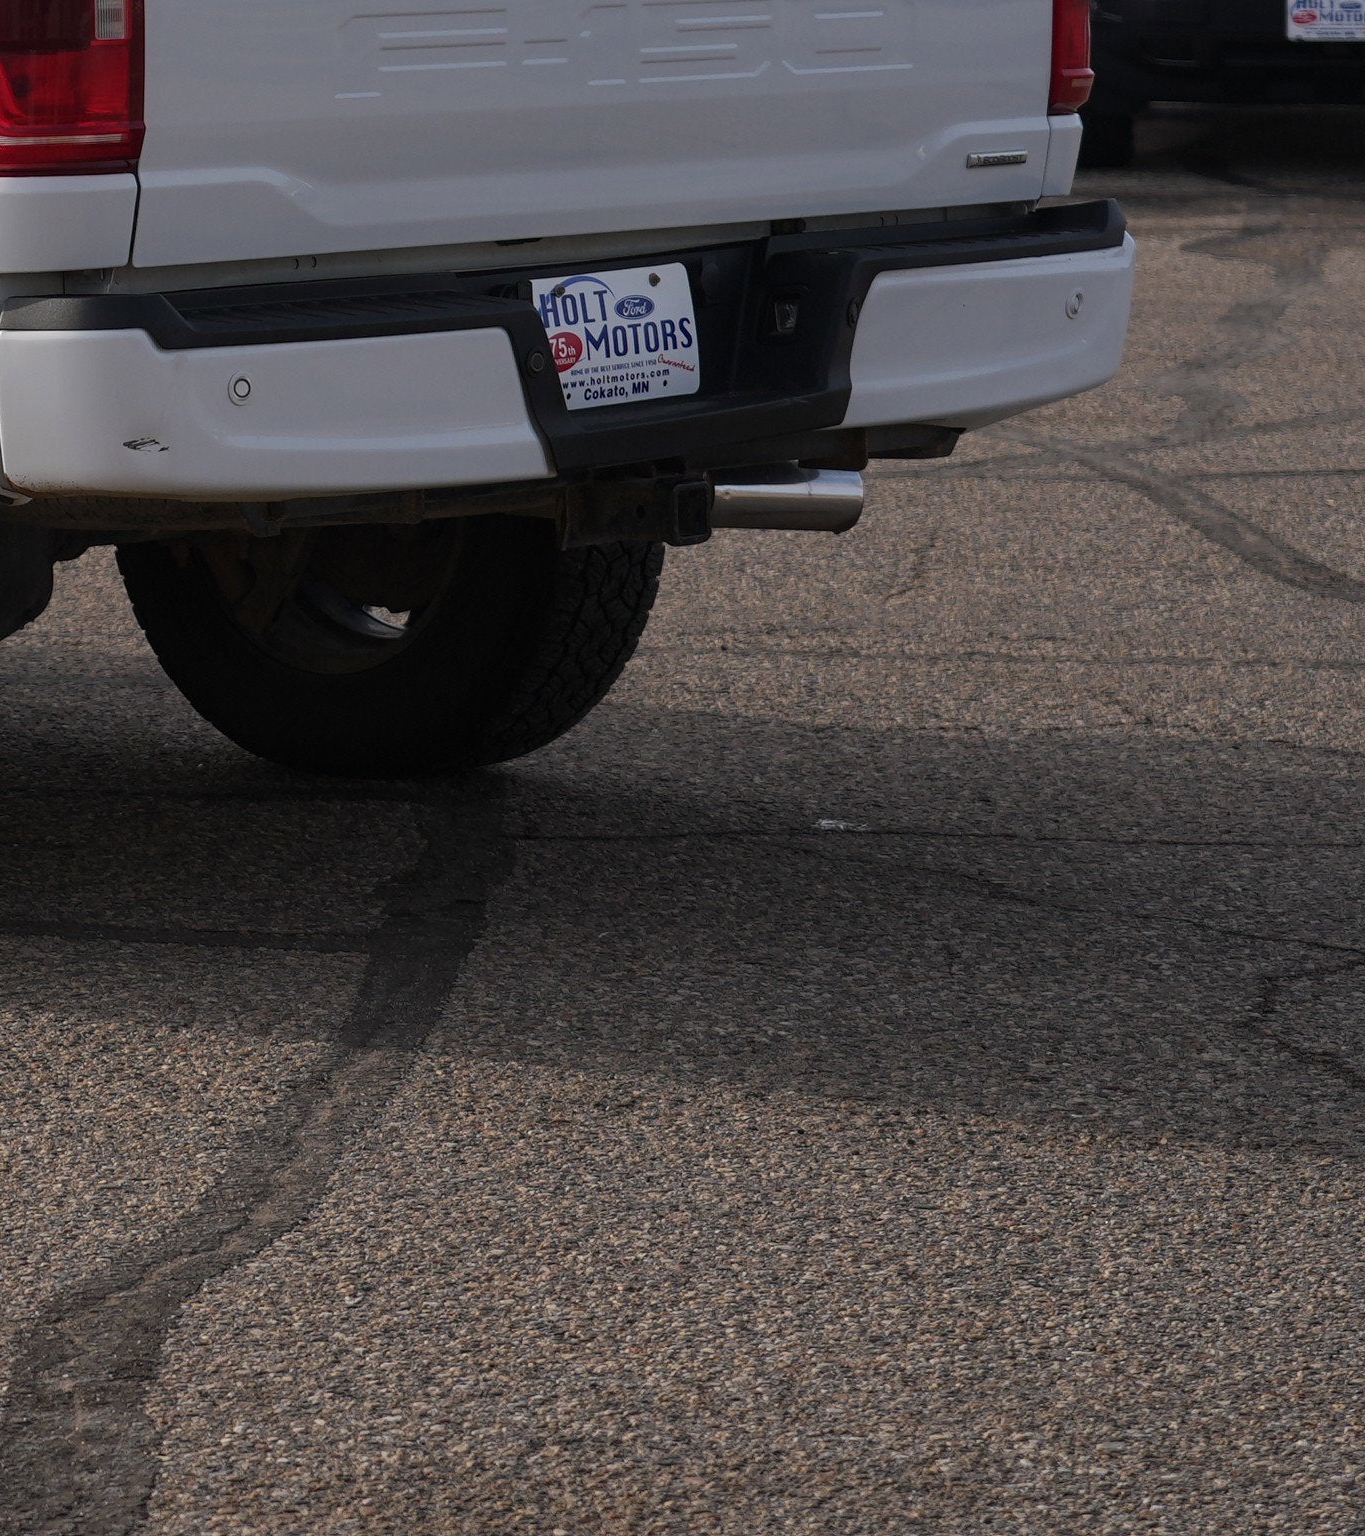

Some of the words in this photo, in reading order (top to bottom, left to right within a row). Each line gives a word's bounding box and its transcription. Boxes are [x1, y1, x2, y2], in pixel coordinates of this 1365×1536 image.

[1319, 10, 1365, 22] MOTO
[539, 289, 609, 328] HOLT
[622, 298, 648, 316] Ford
[549, 337, 577, 358] 75th
[584, 316, 693, 361] MOTORS
[563, 368, 670, 390] www.holtmotors.com
[584, 385, 628, 401] Cokato,
[632, 381, 649, 395] MN
